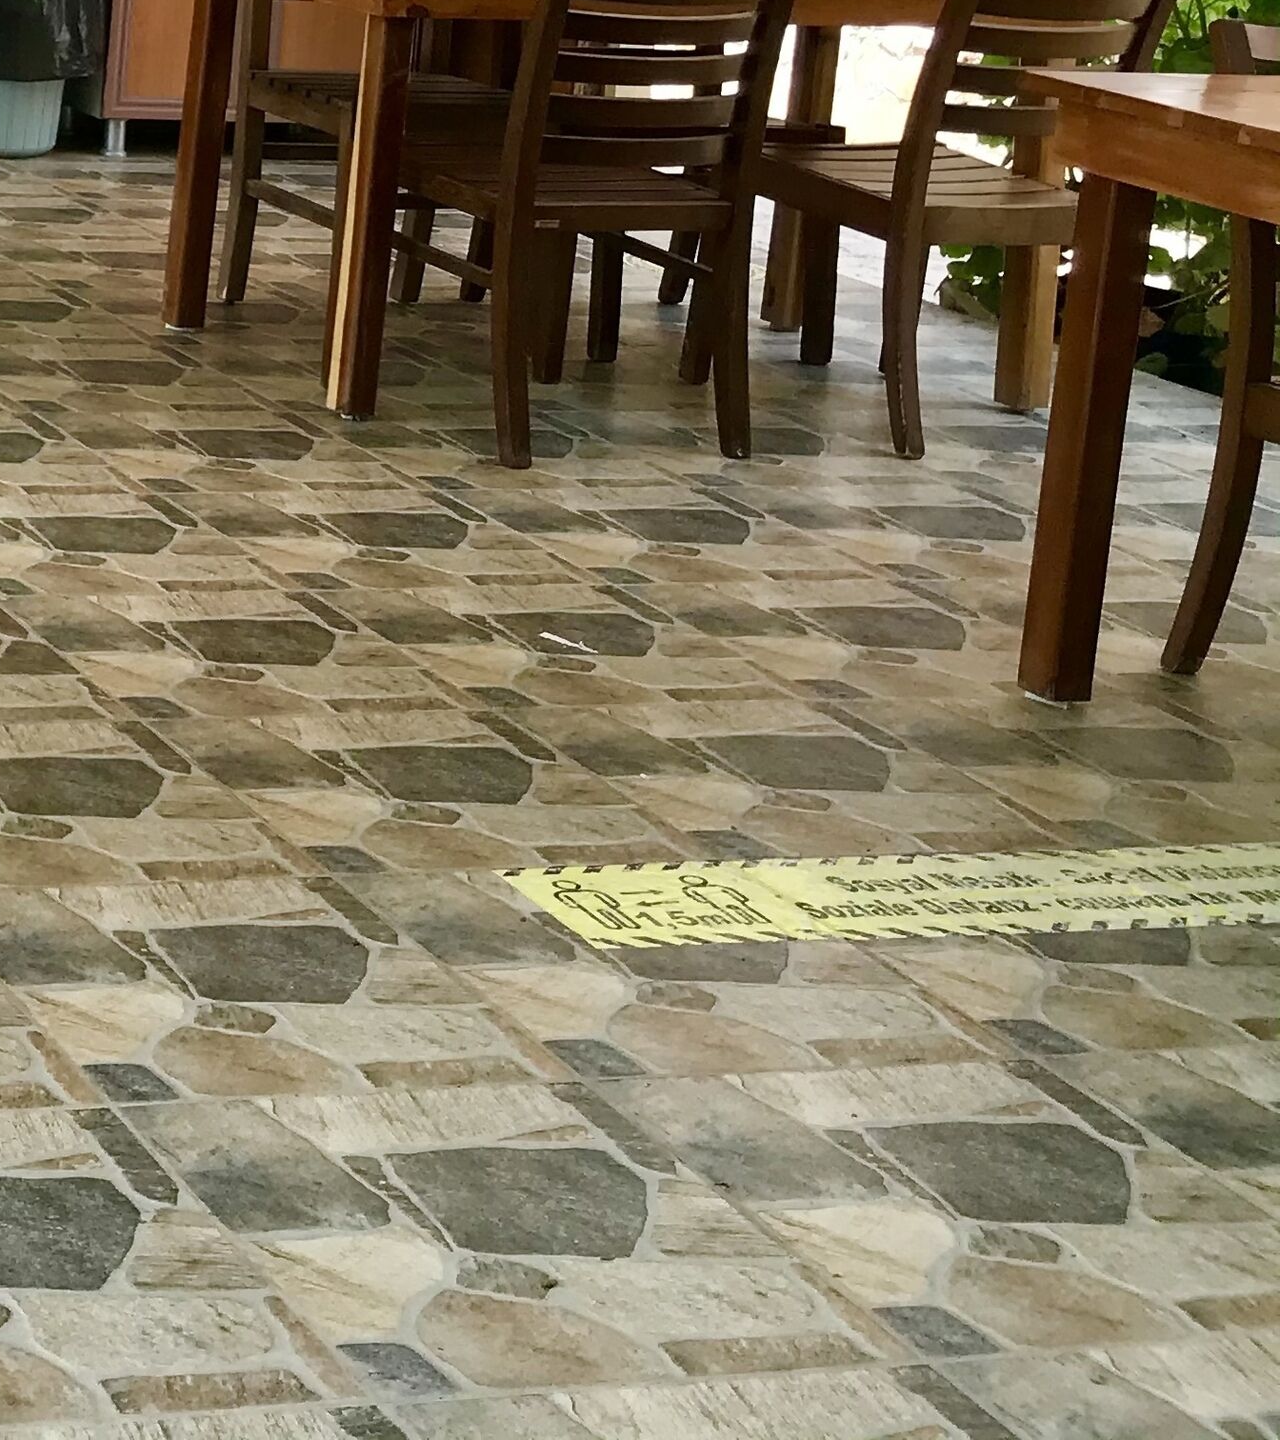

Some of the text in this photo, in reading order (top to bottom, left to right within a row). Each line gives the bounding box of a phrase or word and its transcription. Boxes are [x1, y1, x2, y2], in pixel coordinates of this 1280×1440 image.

[825, 873, 939, 894] Sosyal
[795, 898, 918, 919] Soziale
[913, 898, 1042, 915] Distanz
[635, 910, 733, 930] 1,5m
